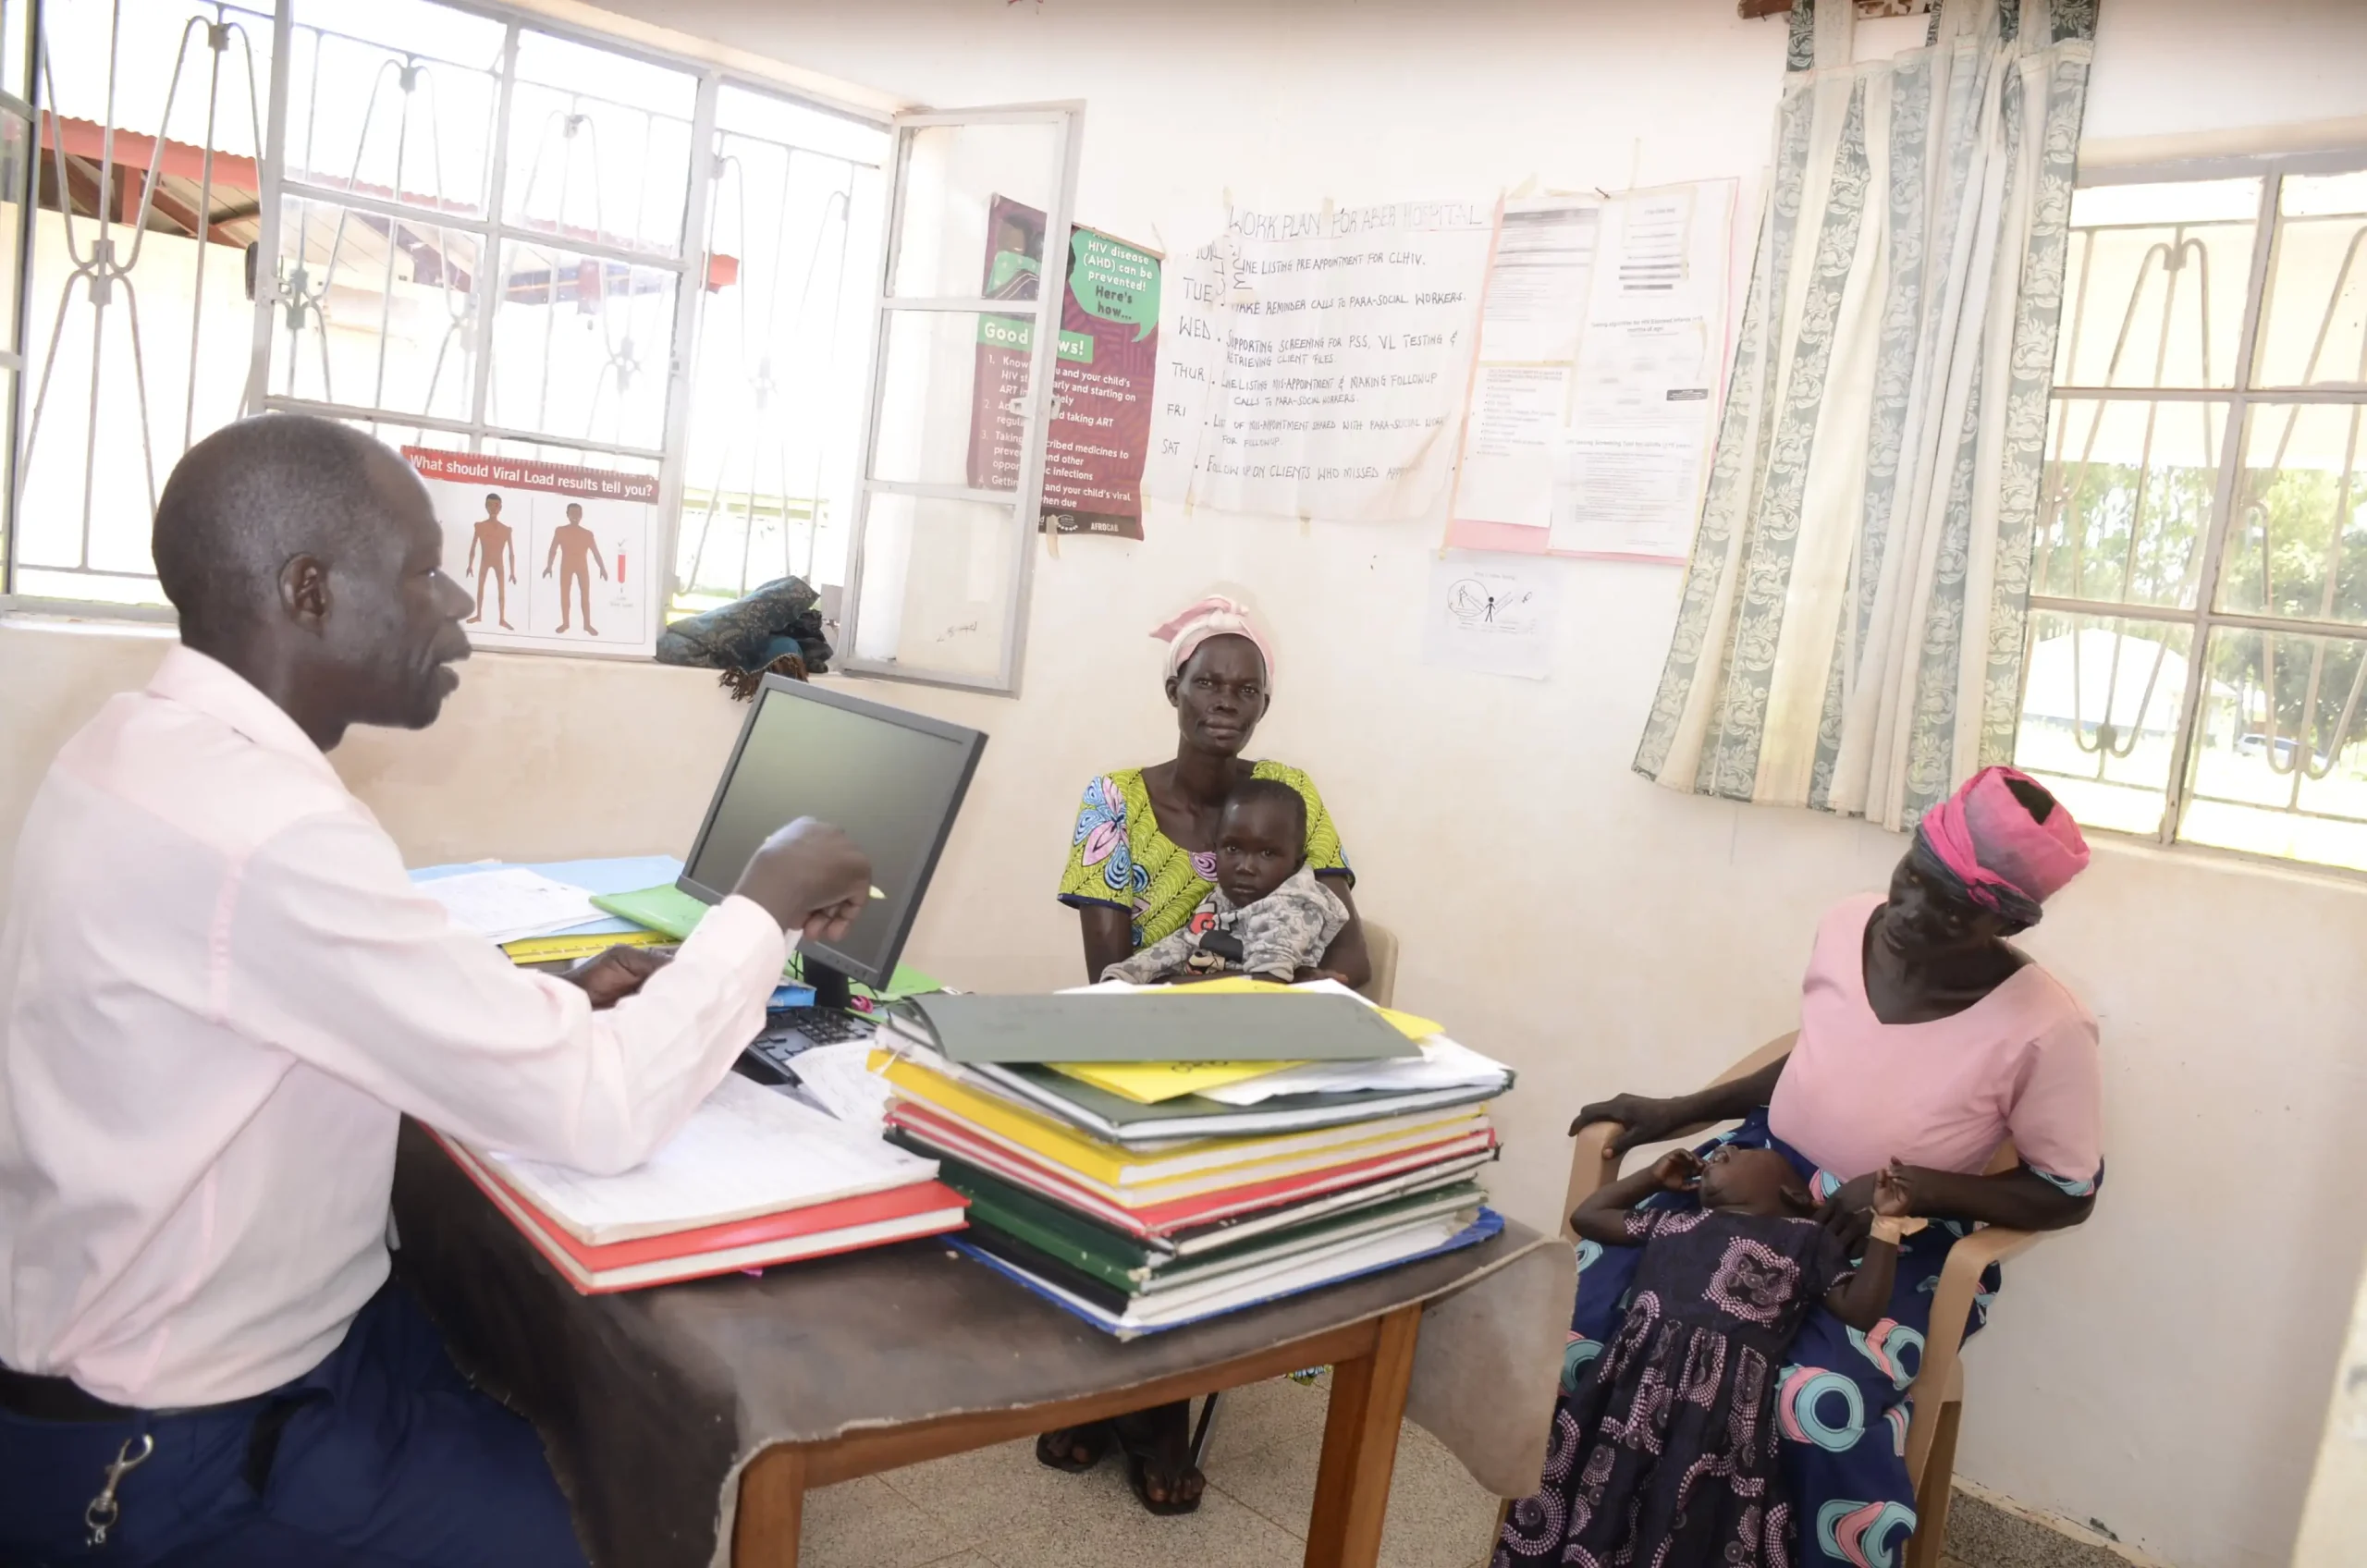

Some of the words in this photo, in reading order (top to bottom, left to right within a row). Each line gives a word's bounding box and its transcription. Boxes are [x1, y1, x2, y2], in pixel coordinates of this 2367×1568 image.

[1229, 205, 1277, 239] WORK
[1282, 213, 1320, 239] PLAN
[1331, 207, 1357, 237] FOR
[1363, 205, 1396, 232] ABER
[1087, 239, 1108, 253] HIV
[1110, 247, 1149, 265] disease
[1083, 253, 1116, 273] (AHD)
[1119, 263, 1136, 276] can
[1140, 266, 1153, 279] be
[1261, 259, 1293, 275] LISTING
[1296, 259, 1311, 272] PRE
[1313, 254, 1364, 271] APPOINTMENT
[1367, 252, 1384, 265] FOR
[1389, 251, 1426, 265] CLHIV.
[1087, 270, 1147, 292] prevented!
[1183, 276, 1213, 303] TUE
[1095, 285, 1133, 304] Here's
[1266, 300, 1306, 315] REMINDER
[1311, 298, 1333, 310] CALLS
[1350, 294, 1409, 308] PARA-SOCIAL
[1415, 291, 1466, 306] WORKERS.
[1098, 301, 1133, 320] how...
[985, 322, 1028, 345] Good
[1178, 315, 1210, 340] WED
[1278, 337, 1324, 353] SCREENING
[1328, 337, 1342, 349] FOR
[1379, 335, 1396, 350] VL
[1403, 333, 1442, 349] TESTING
[1277, 353, 1308, 364] CLIENT
[988, 354, 996, 364] 1.
[1061, 368, 1080, 378] and
[1081, 371, 1101, 383] your
[1103, 375, 1131, 388] child's
[1171, 361, 1206, 382] THUR
[999, 384, 1018, 394] ART
[1001, 370, 1018, 380] HIV
[1072, 383, 1088, 394] and
[1090, 386, 1123, 402] starting
[1124, 394, 1136, 402] on
[1350, 375, 1386, 389] MAKING
[1167, 403, 1186, 417] FRI
[1233, 397, 1259, 406] CALLS
[1275, 395, 1320, 406] PARA-SOCIAL
[1066, 412, 1094, 427] taking
[1096, 417, 1114, 427] ART
[1312, 421, 1336, 431] SHARED
[1343, 420, 1364, 431] WITH
[1161, 438, 1180, 455] SAT
[1222, 435, 1238, 445] FOR
[1061, 456, 1085, 466] other
[1074, 445, 1118, 459] medicines
[1120, 449, 1129, 459] to
[411, 453, 443, 472] What
[447, 460, 488, 478] should
[493, 466, 520, 482] Viral
[524, 470, 555, 486] Load
[558, 476, 598, 491] results
[602, 480, 620, 495] tell
[624, 484, 653, 498] you?
[1052, 468, 1093, 481] infections
[1252, 466, 1266, 479] ON
[1269, 465, 1311, 481] CLIENTS
[1318, 467, 1340, 481] WHO
[1343, 466, 1380, 479] MISSED
[1045, 483, 1061, 492] and
[1062, 485, 1081, 496] your
[1083, 488, 1110, 499] child's
[1111, 492, 1131, 501] viral
[1061, 497, 1078, 508] due
